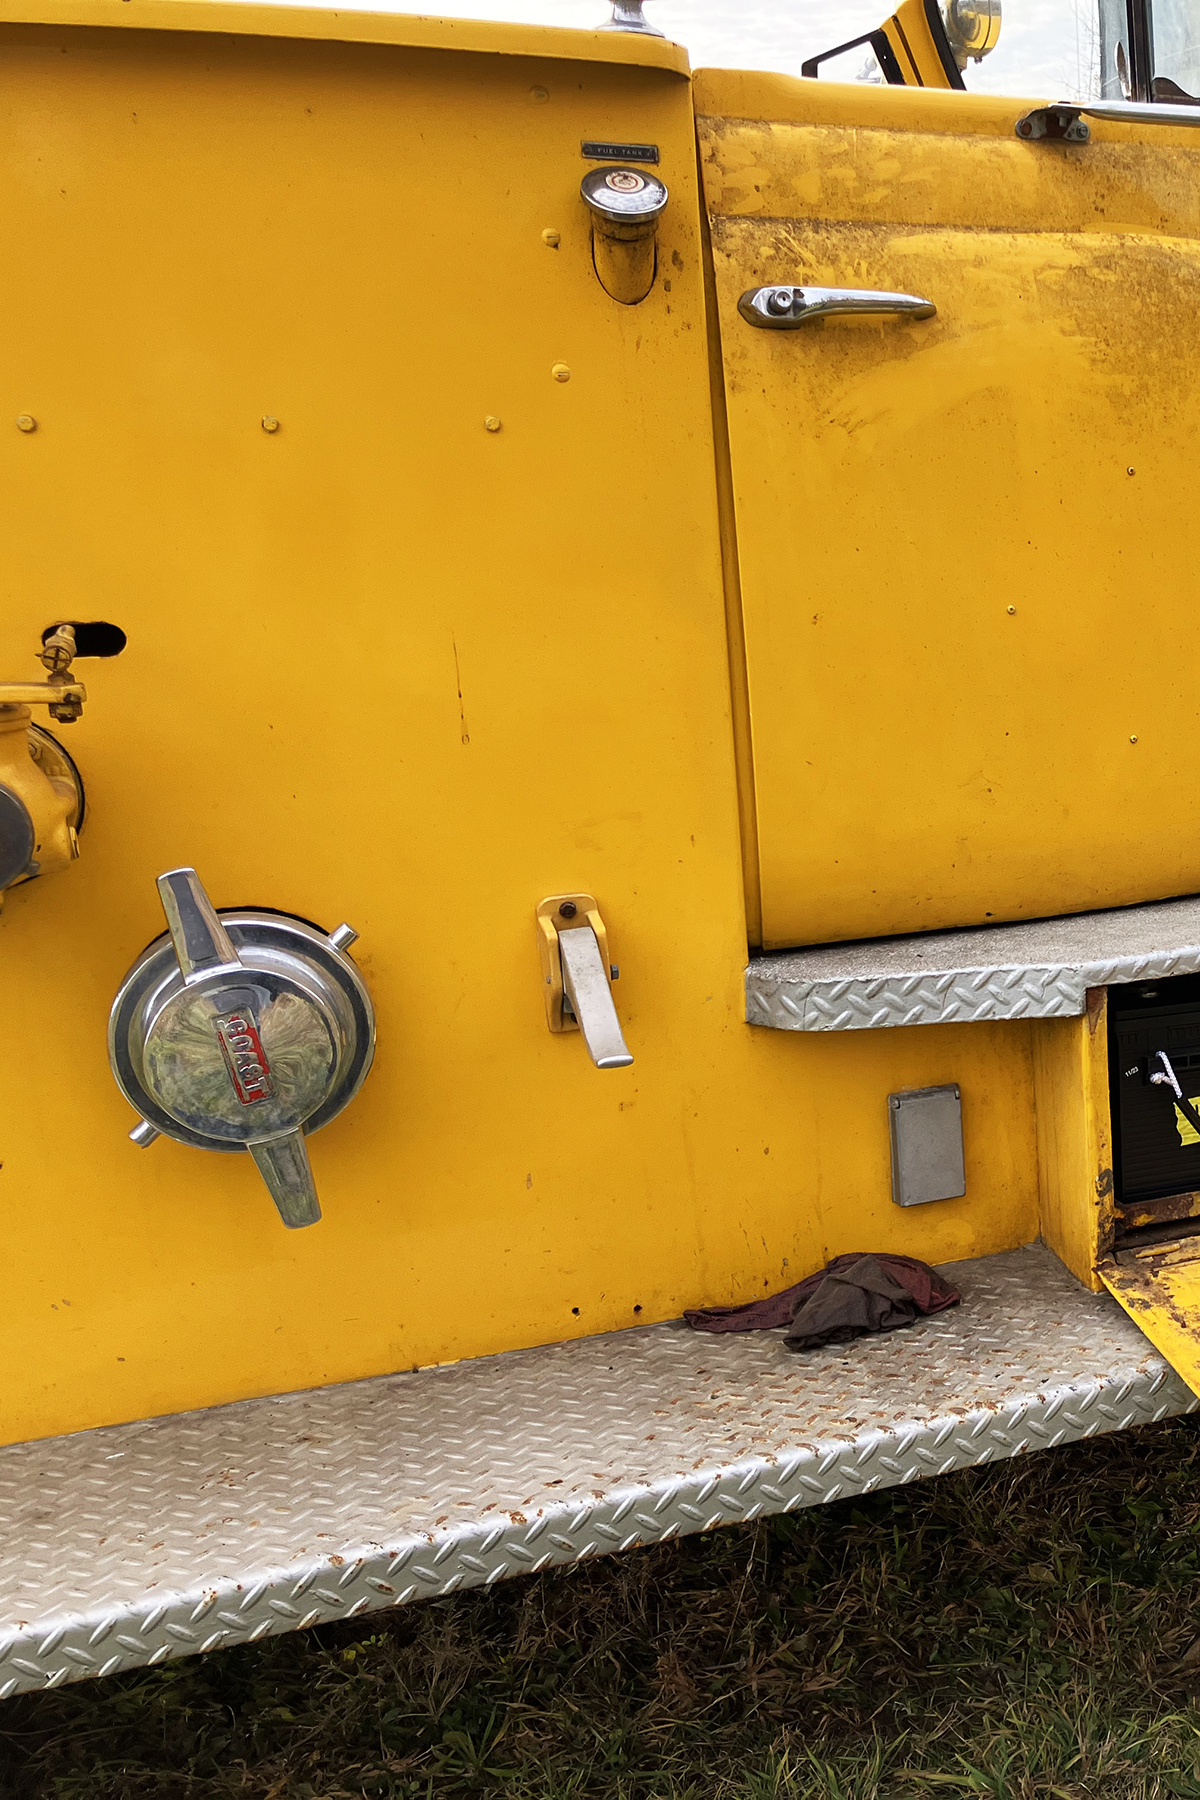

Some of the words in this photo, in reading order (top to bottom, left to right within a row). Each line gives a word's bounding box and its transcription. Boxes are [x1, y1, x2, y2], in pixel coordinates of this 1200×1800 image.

[597, 147, 618, 155] FUEL
[621, 149, 644, 157] TANK
[221, 1018, 271, 1097] COAST
